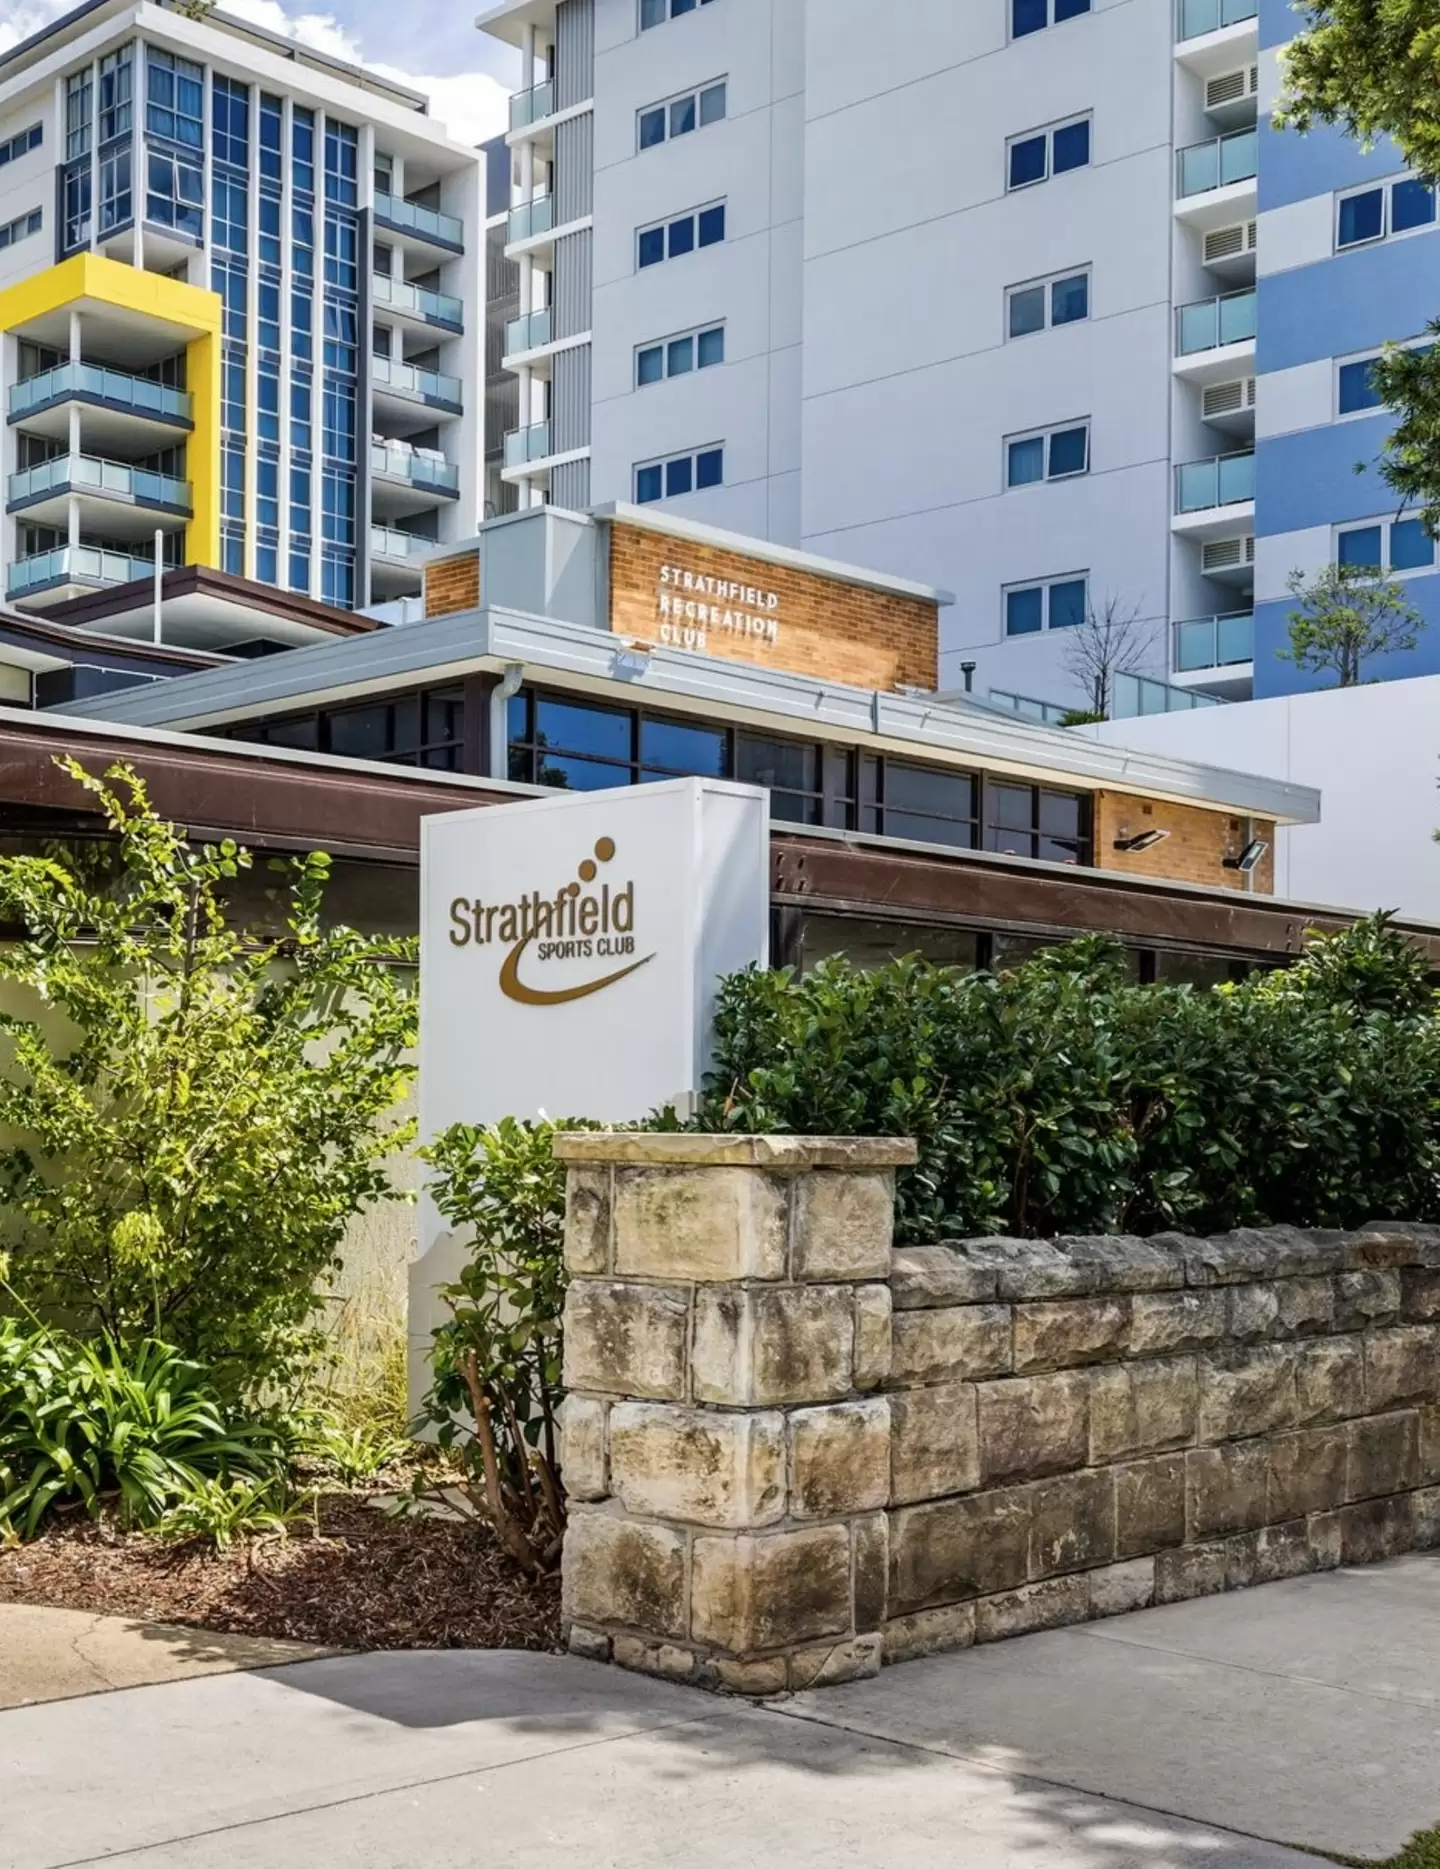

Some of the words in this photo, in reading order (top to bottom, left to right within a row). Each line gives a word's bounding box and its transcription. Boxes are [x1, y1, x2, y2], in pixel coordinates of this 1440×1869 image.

[660, 565, 778, 610] STRATHFIELD
[660, 595, 778, 639] RECREATION
[660, 624, 707, 648] CLUB
[449, 880, 633, 946] Strathfield
[537, 939, 592, 961] SPORTS
[597, 936, 635, 956] CLUB
